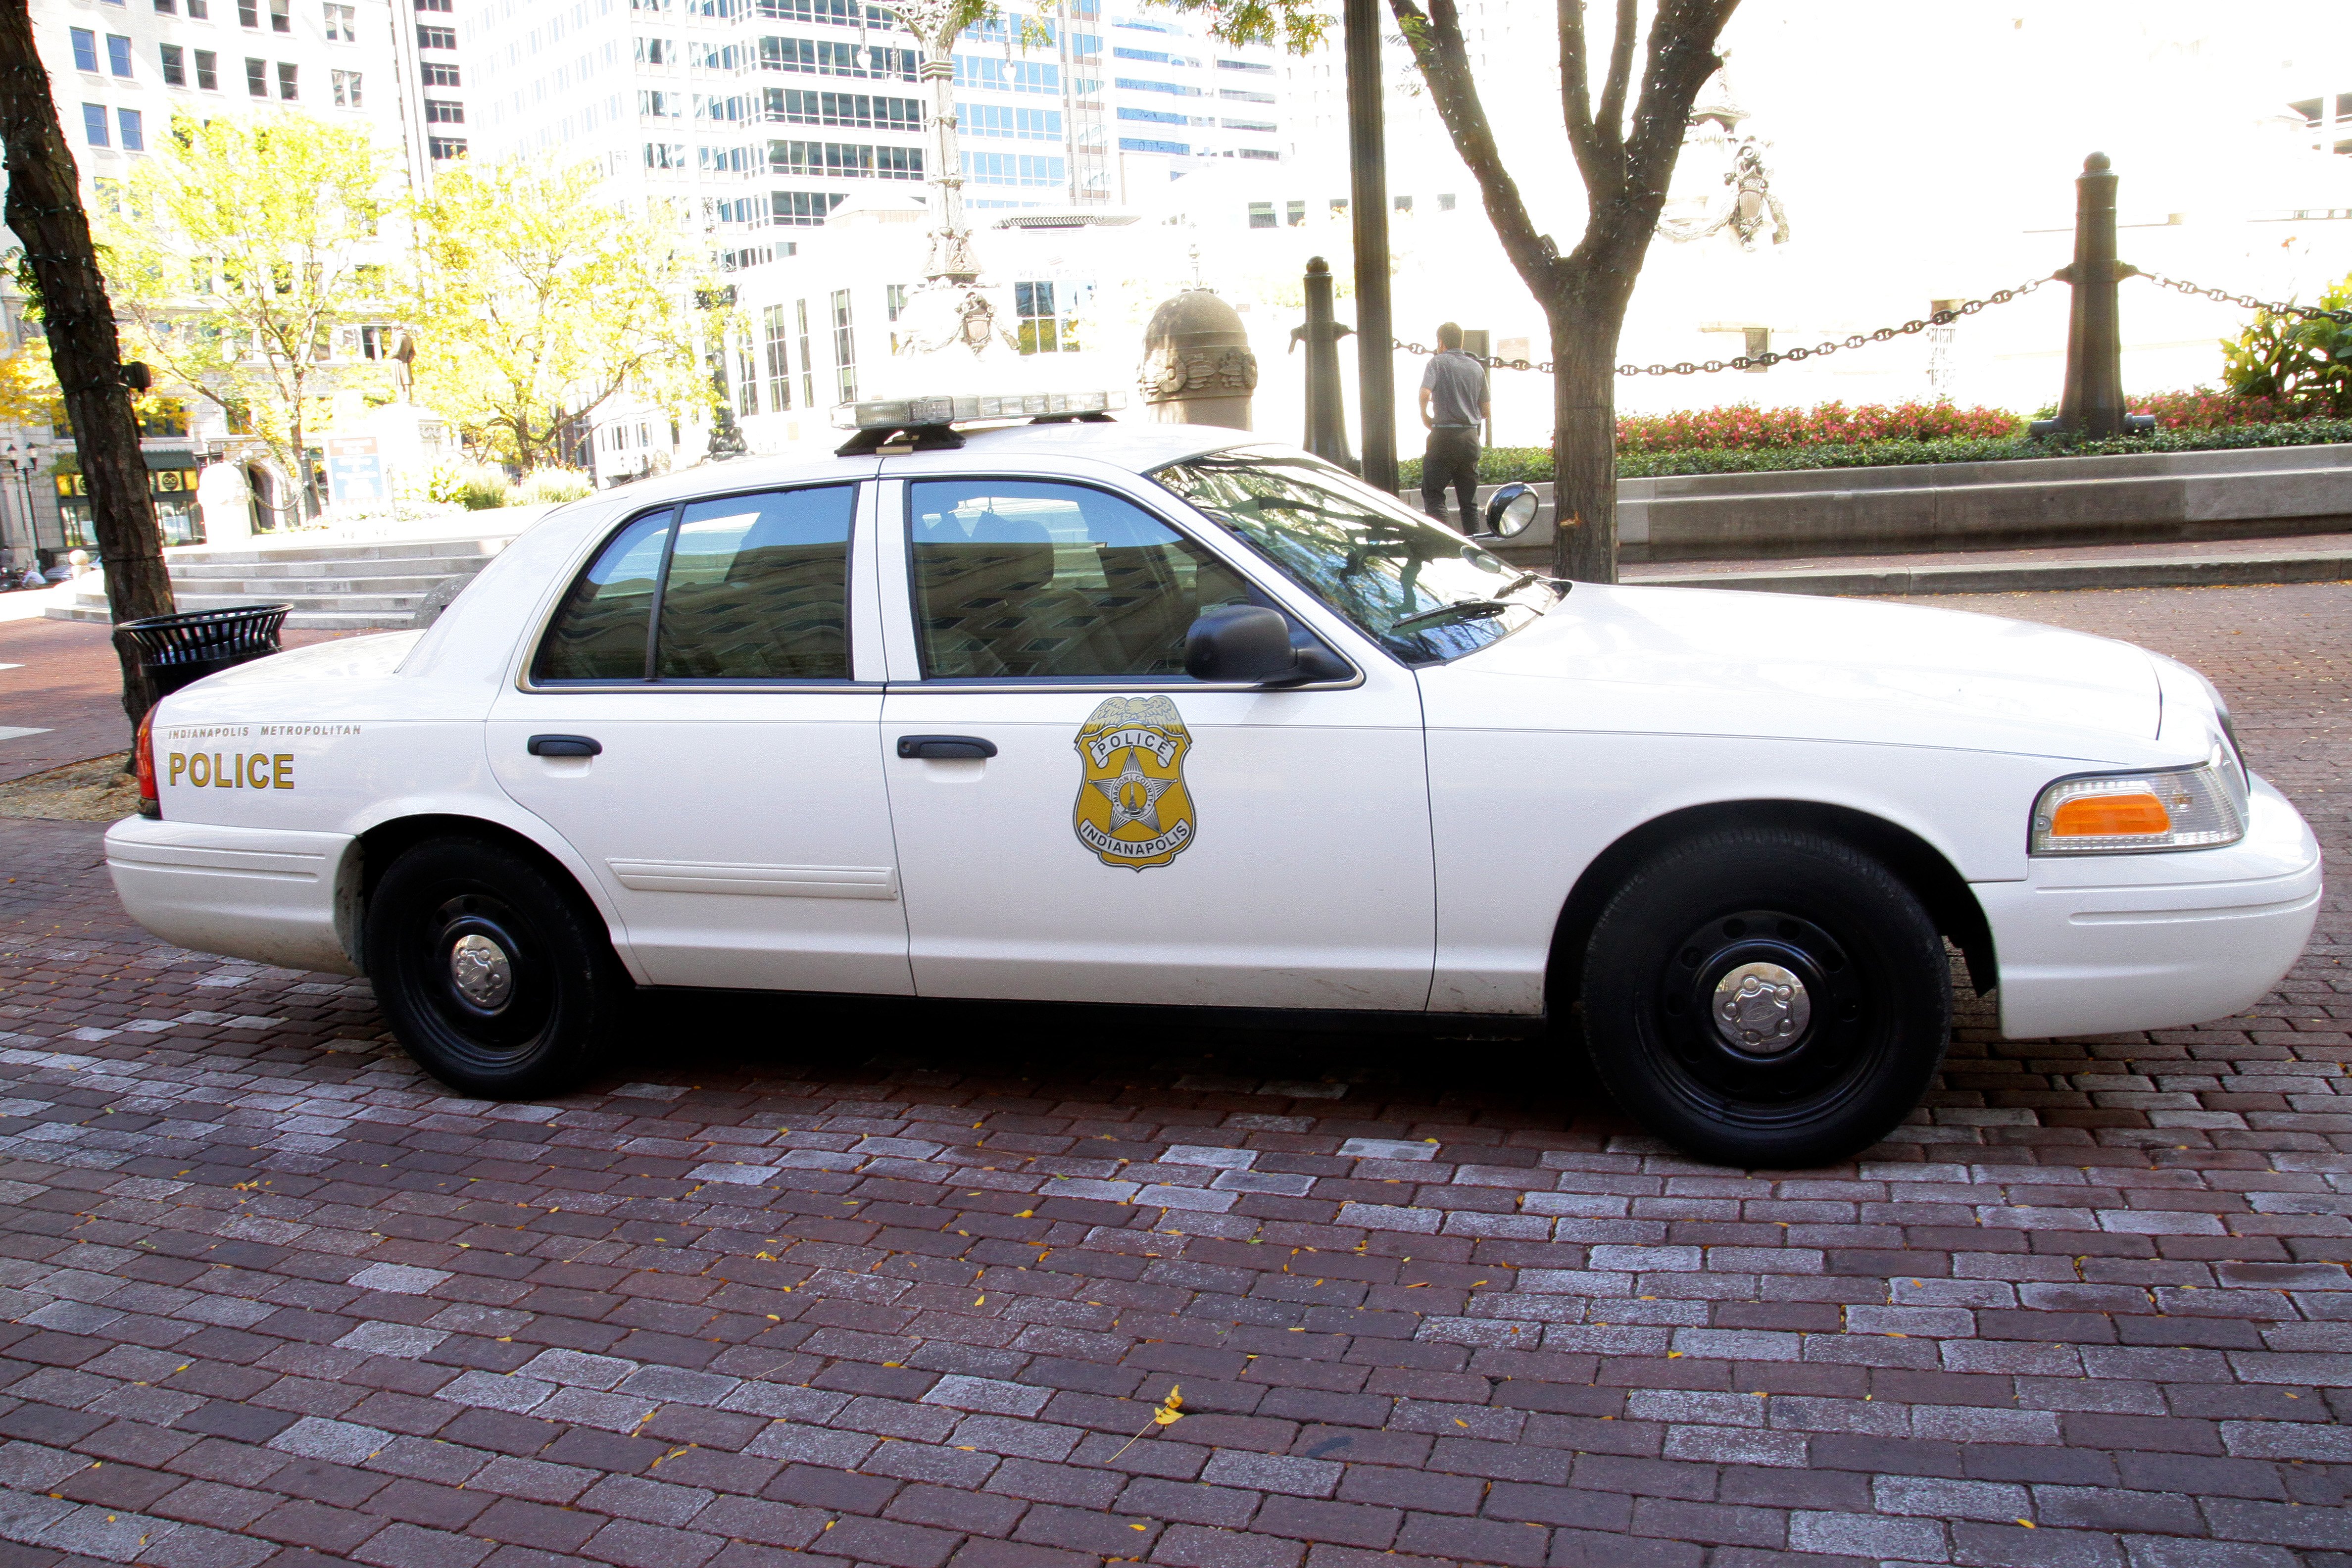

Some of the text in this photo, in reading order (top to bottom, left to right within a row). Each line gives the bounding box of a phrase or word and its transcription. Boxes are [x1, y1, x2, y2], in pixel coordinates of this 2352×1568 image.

[168, 725, 362, 740] INDIANAPOLIS METROPOLITAN
[1097, 733, 1169, 755] POLICE
[169, 752, 295, 789] POLICE
[1113, 775, 1153, 803] MARION COUNTY
[1082, 825, 1188, 855] INDIANAPOLIS
